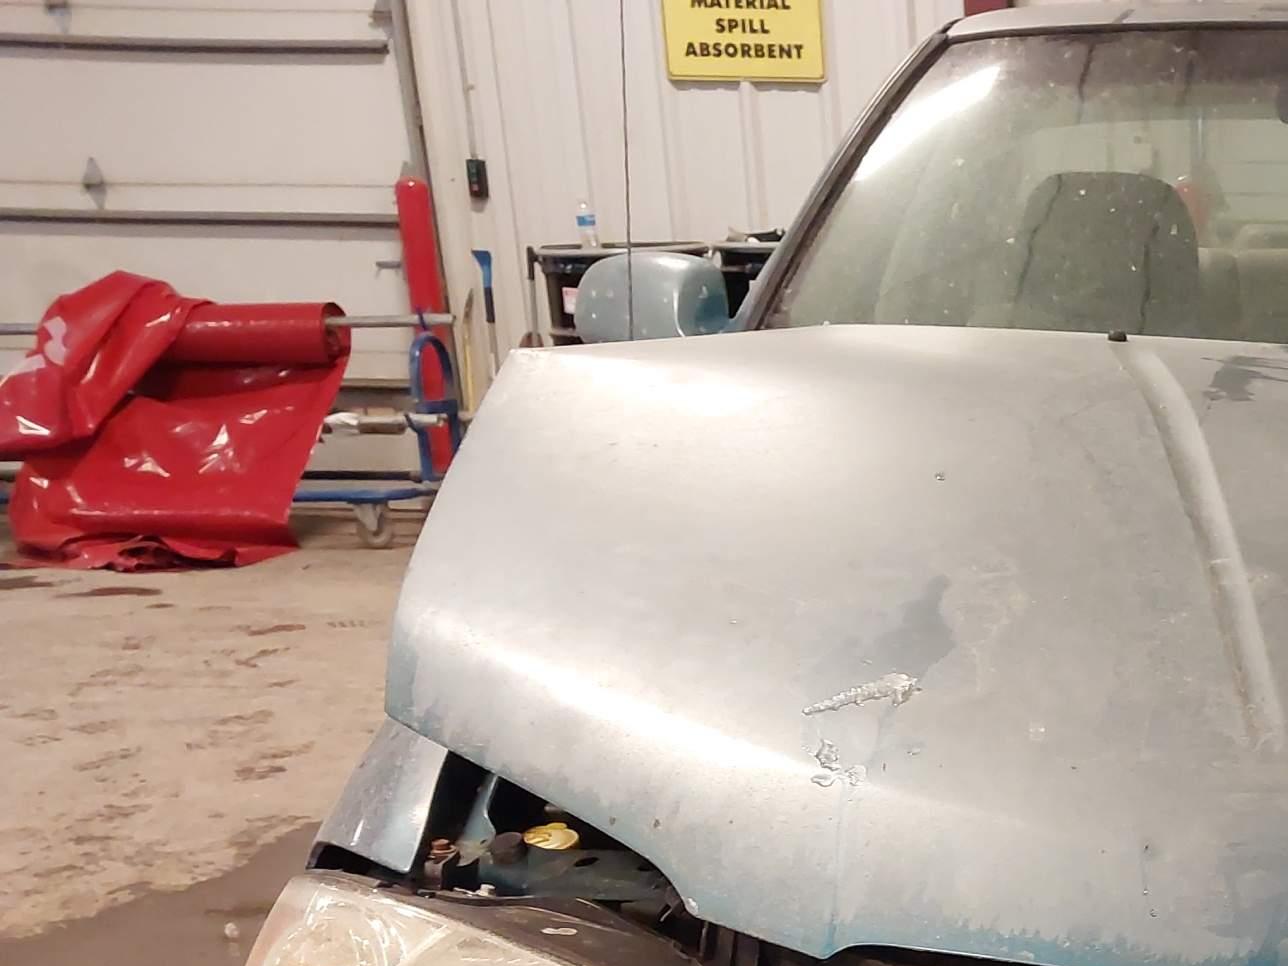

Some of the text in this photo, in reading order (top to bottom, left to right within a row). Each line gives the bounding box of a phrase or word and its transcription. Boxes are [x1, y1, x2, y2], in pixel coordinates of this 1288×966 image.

[690, 0, 792, 10] MATERIAL
[715, 17, 770, 34] SPILL
[685, 42, 803, 59] ABSORBENT
